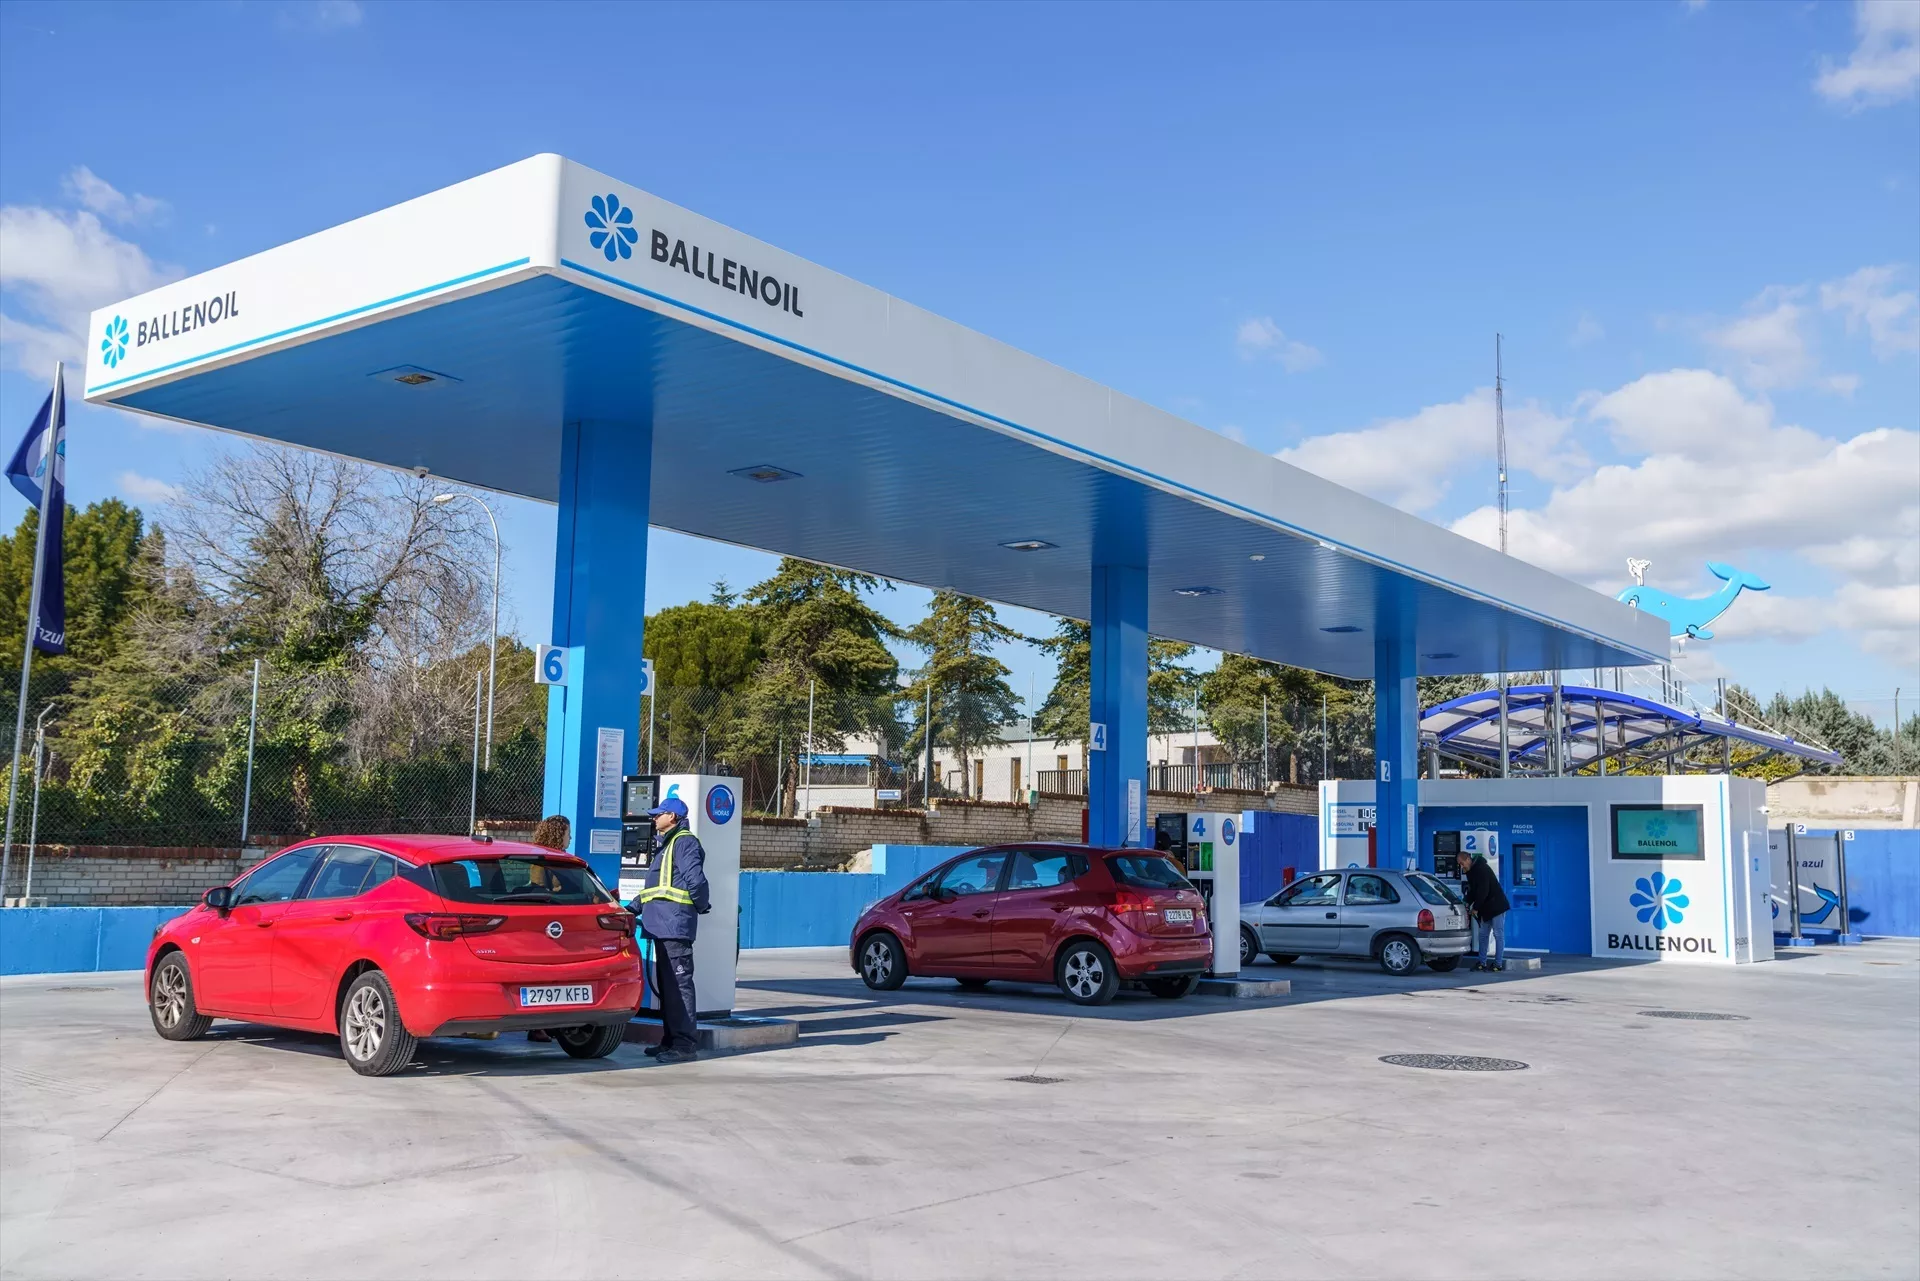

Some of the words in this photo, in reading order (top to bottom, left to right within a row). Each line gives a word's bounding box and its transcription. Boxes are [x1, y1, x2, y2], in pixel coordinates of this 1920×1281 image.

[651, 229, 803, 318] BALLENOIL
[137, 291, 239, 347] BALLENOIL
[544, 649, 563, 682] 6
[1094, 725, 1104, 748] 4
[1384, 762, 1389, 780] 2
[1192, 817, 1206, 837] 4
[1797, 824, 1805, 833] 2
[1846, 831, 1854, 840] 3
[1465, 835, 1477, 850] 2
[1637, 839, 1678, 848] BALLENOIL
[1801, 859, 1824, 869] azul
[1607, 933, 1717, 954] BALLENOIL
[529, 989, 562, 1004] 2797
[565, 986, 591, 1003] KFB
